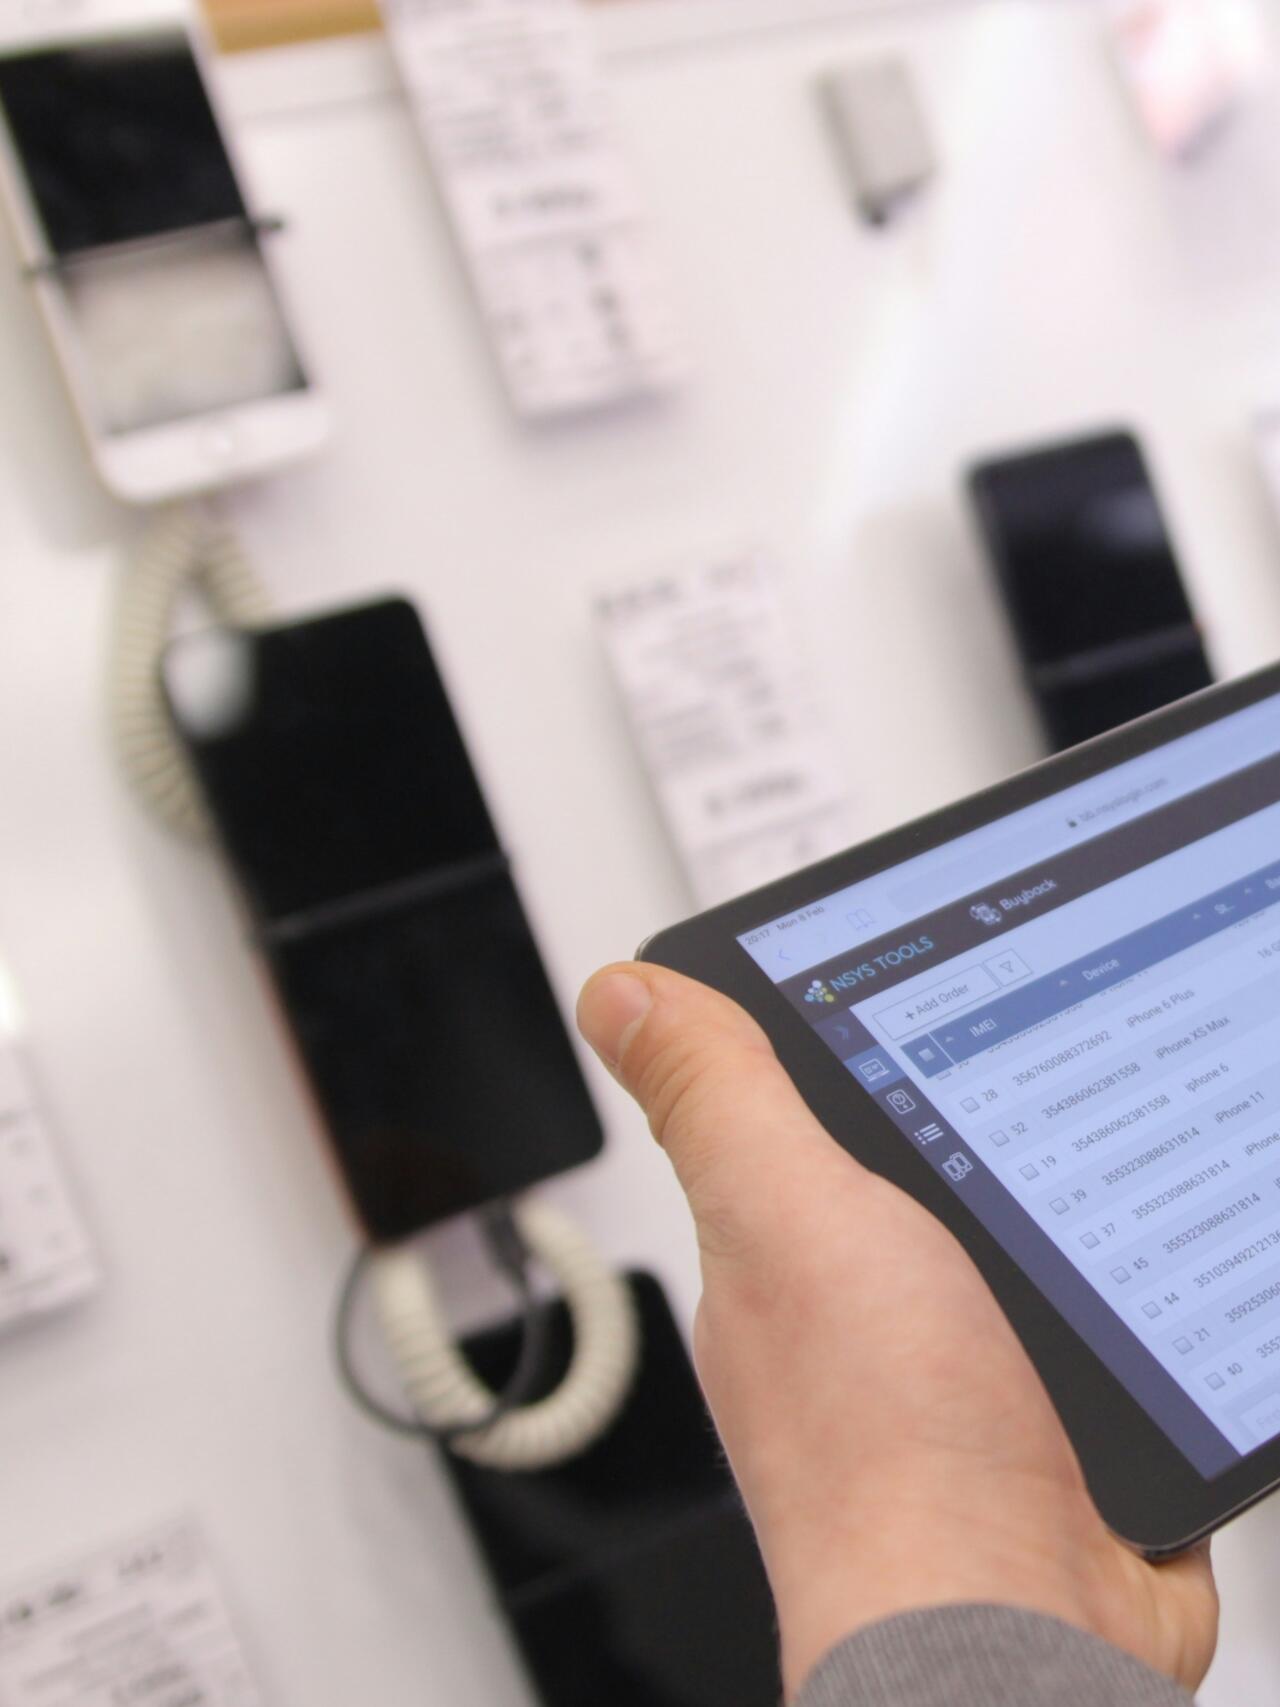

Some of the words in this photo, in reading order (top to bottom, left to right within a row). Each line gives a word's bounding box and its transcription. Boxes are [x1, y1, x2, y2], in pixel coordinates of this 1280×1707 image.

[999, 880, 1056, 910] Buyback
[744, 929, 774, 945] 20:17
[776, 919, 797, 930] Mon
[797, 913, 806, 921] 8
[805, 906, 825, 919] Feb
[830, 964, 876, 991] NSYS
[873, 936, 933, 969] TOOLS
[1082, 959, 1119, 980] Device
[916, 998, 939, 1015] Add
[938, 984, 969, 1003] Order
[970, 1019, 997, 1037] IMEI
[982, 1089, 998, 1102] 28
[1013, 1031, 1111, 1085] 356760088372692
[1127, 1006, 1163, 1028] iPhone
[1161, 1000, 1172, 1009] 6
[1169, 989, 1195, 1005] Plus
[1257, 948, 1273, 958] 16
[1010, 1121, 1028, 1135] 52
[1042, 1063, 1140, 1118] 354386062381558
[1156, 1037, 1192, 1059] iPhone
[1190, 1027, 1208, 1040] XS
[1205, 1017, 1230, 1032] Max
[1041, 1155, 1057, 1168] 19
[1072, 1095, 1170, 1151] 354386062381558
[1185, 1069, 1220, 1092] iphone
[1219, 1063, 1229, 1072] 6
[1102, 1127, 1200, 1185] 355323088631814
[1215, 1101, 1251, 1123] iPhone
[1249, 1091, 1265, 1103] 11
[1132, 1160, 1230, 1219] 355323088631814
[1245, 1133, 1280, 1156] iPhone
[1163, 1193, 1260, 1253] 355323088631814
[1193, 1327, 1210, 1342] 21
